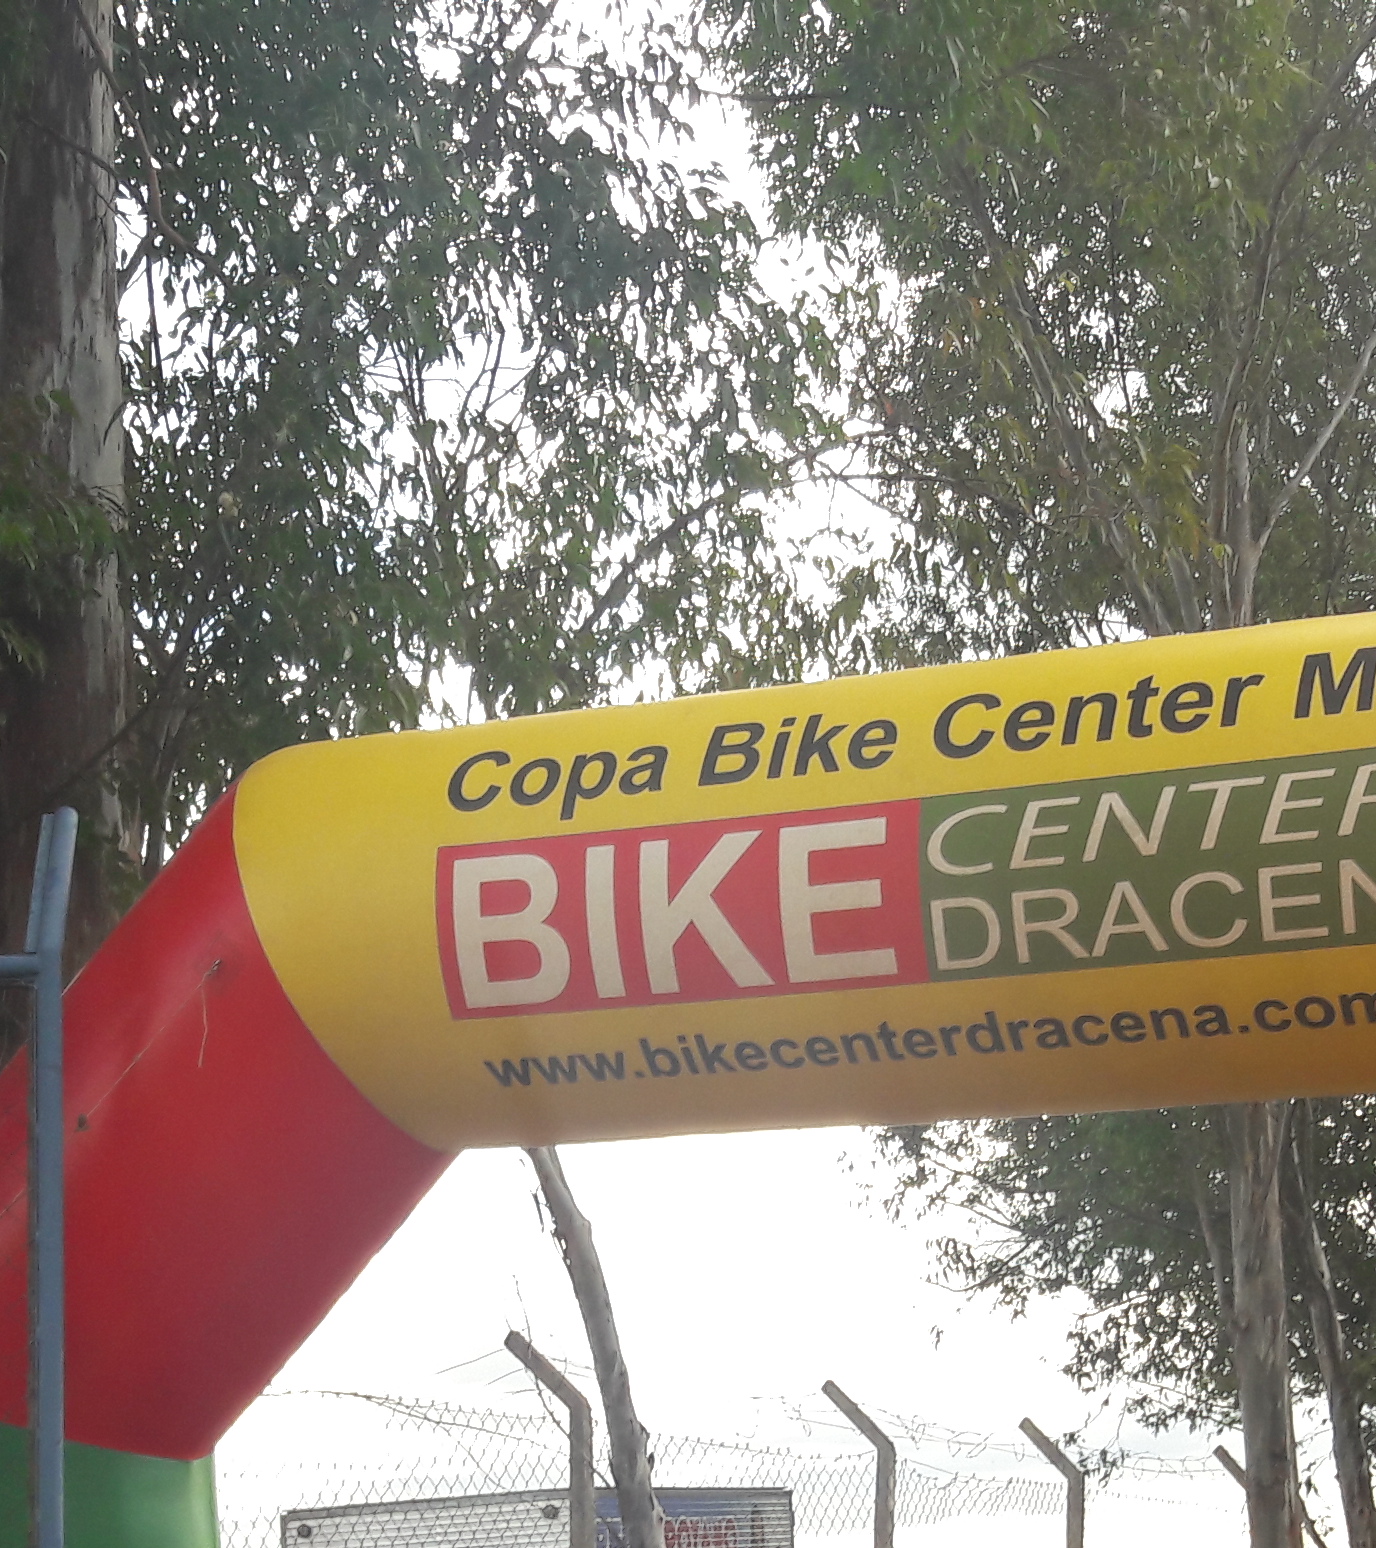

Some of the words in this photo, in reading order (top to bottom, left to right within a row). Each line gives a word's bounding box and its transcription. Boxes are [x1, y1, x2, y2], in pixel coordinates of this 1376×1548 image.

[447, 746, 668, 820] Copa
[698, 714, 898, 787] Bike
[932, 674, 1265, 759] Center
[452, 816, 899, 1009] BIKE
